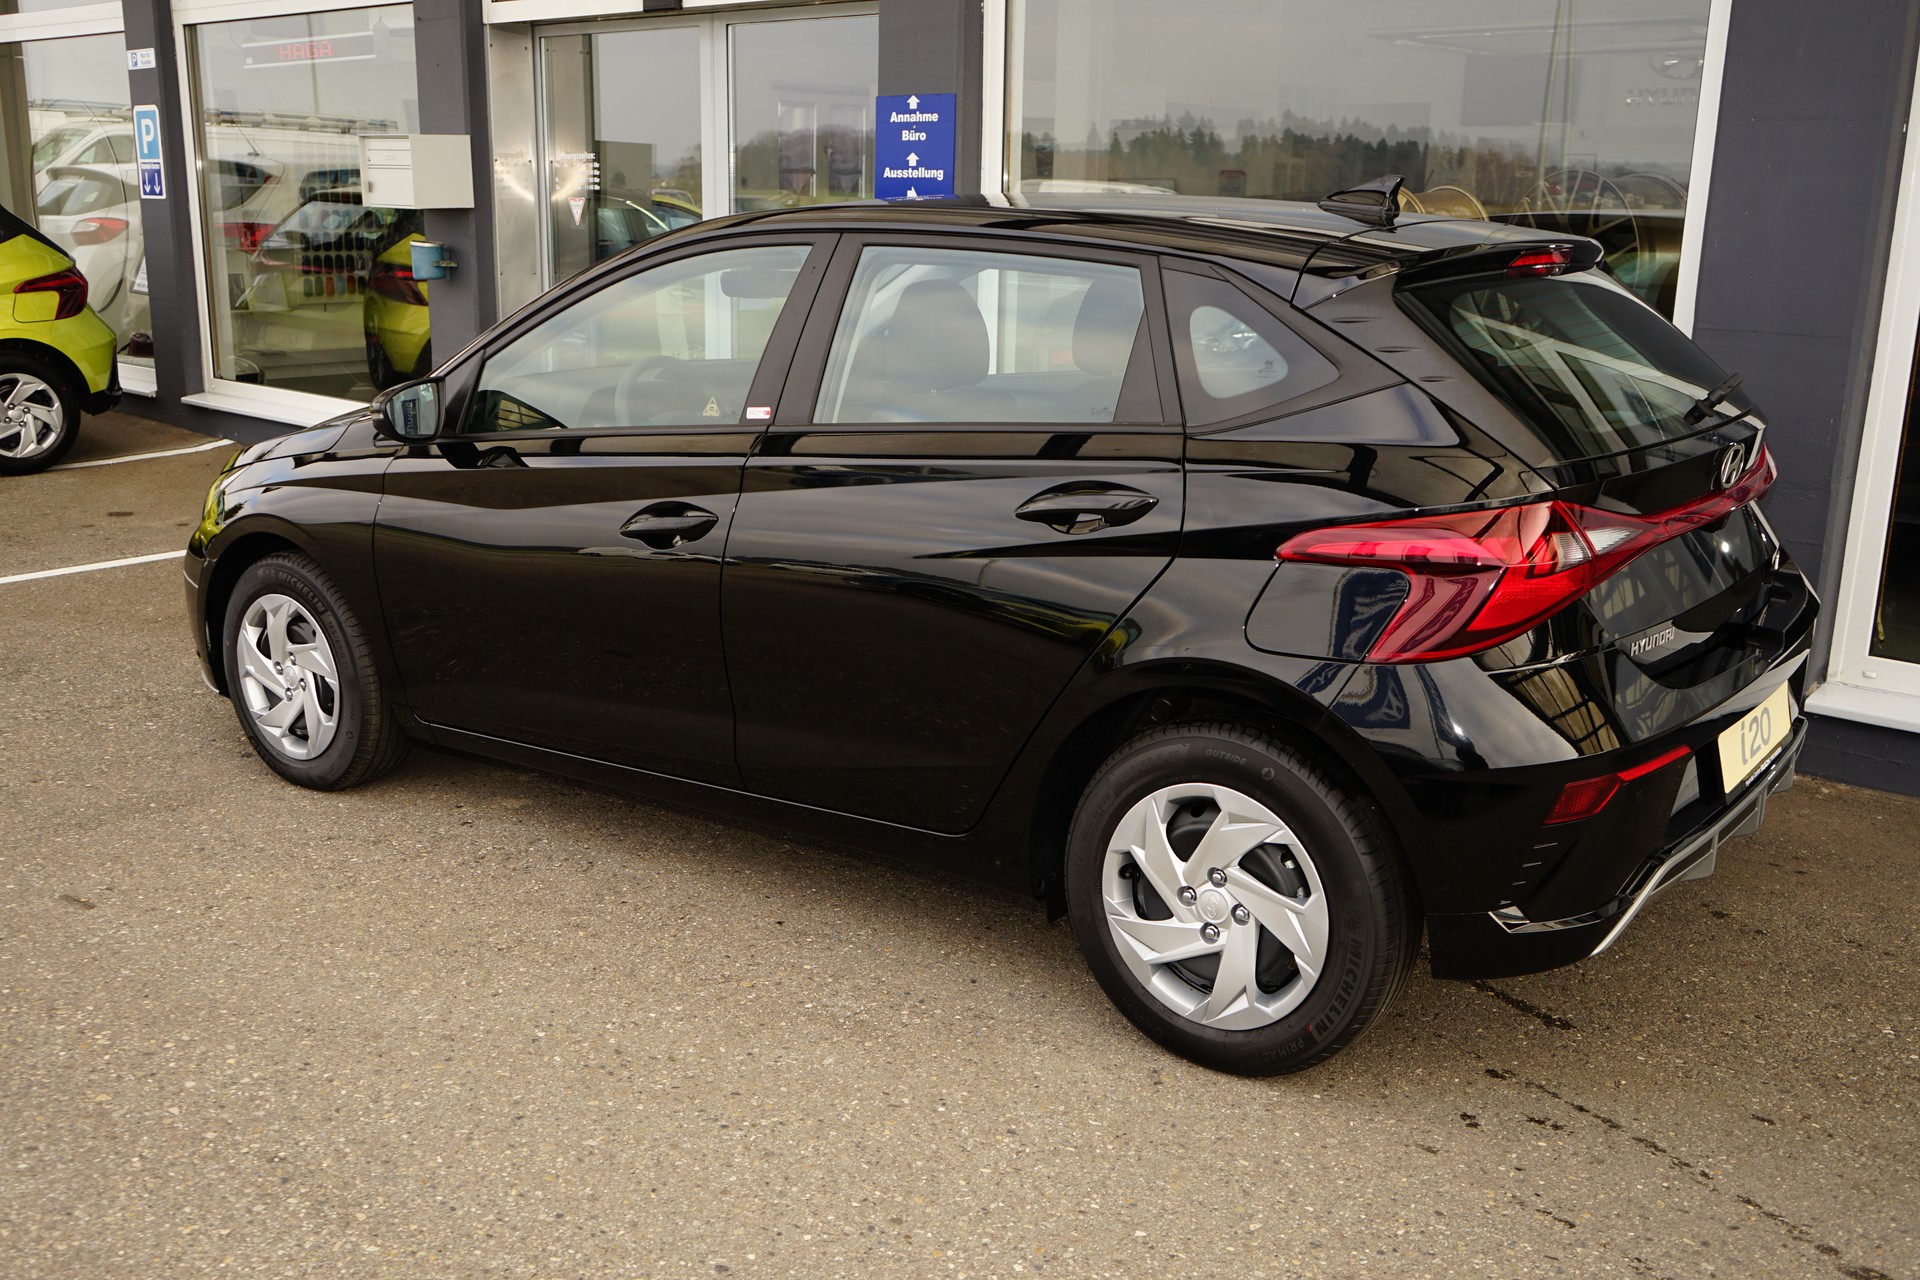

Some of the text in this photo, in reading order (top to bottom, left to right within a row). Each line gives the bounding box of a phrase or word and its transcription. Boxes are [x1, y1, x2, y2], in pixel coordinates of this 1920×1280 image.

[279, 41, 333, 60] HAGA
[890, 111, 939, 122] Annahme
[140, 119, 154, 154] P
[902, 130, 926, 141] Büro
[883, 167, 944, 181] Ausstellung
[1630, 626, 1675, 657] HYUNDAI
[1741, 706, 1771, 766] i20
[1205, 748, 1248, 767] OUTSIDE
[1313, 938, 1363, 1037] MICHELIN
